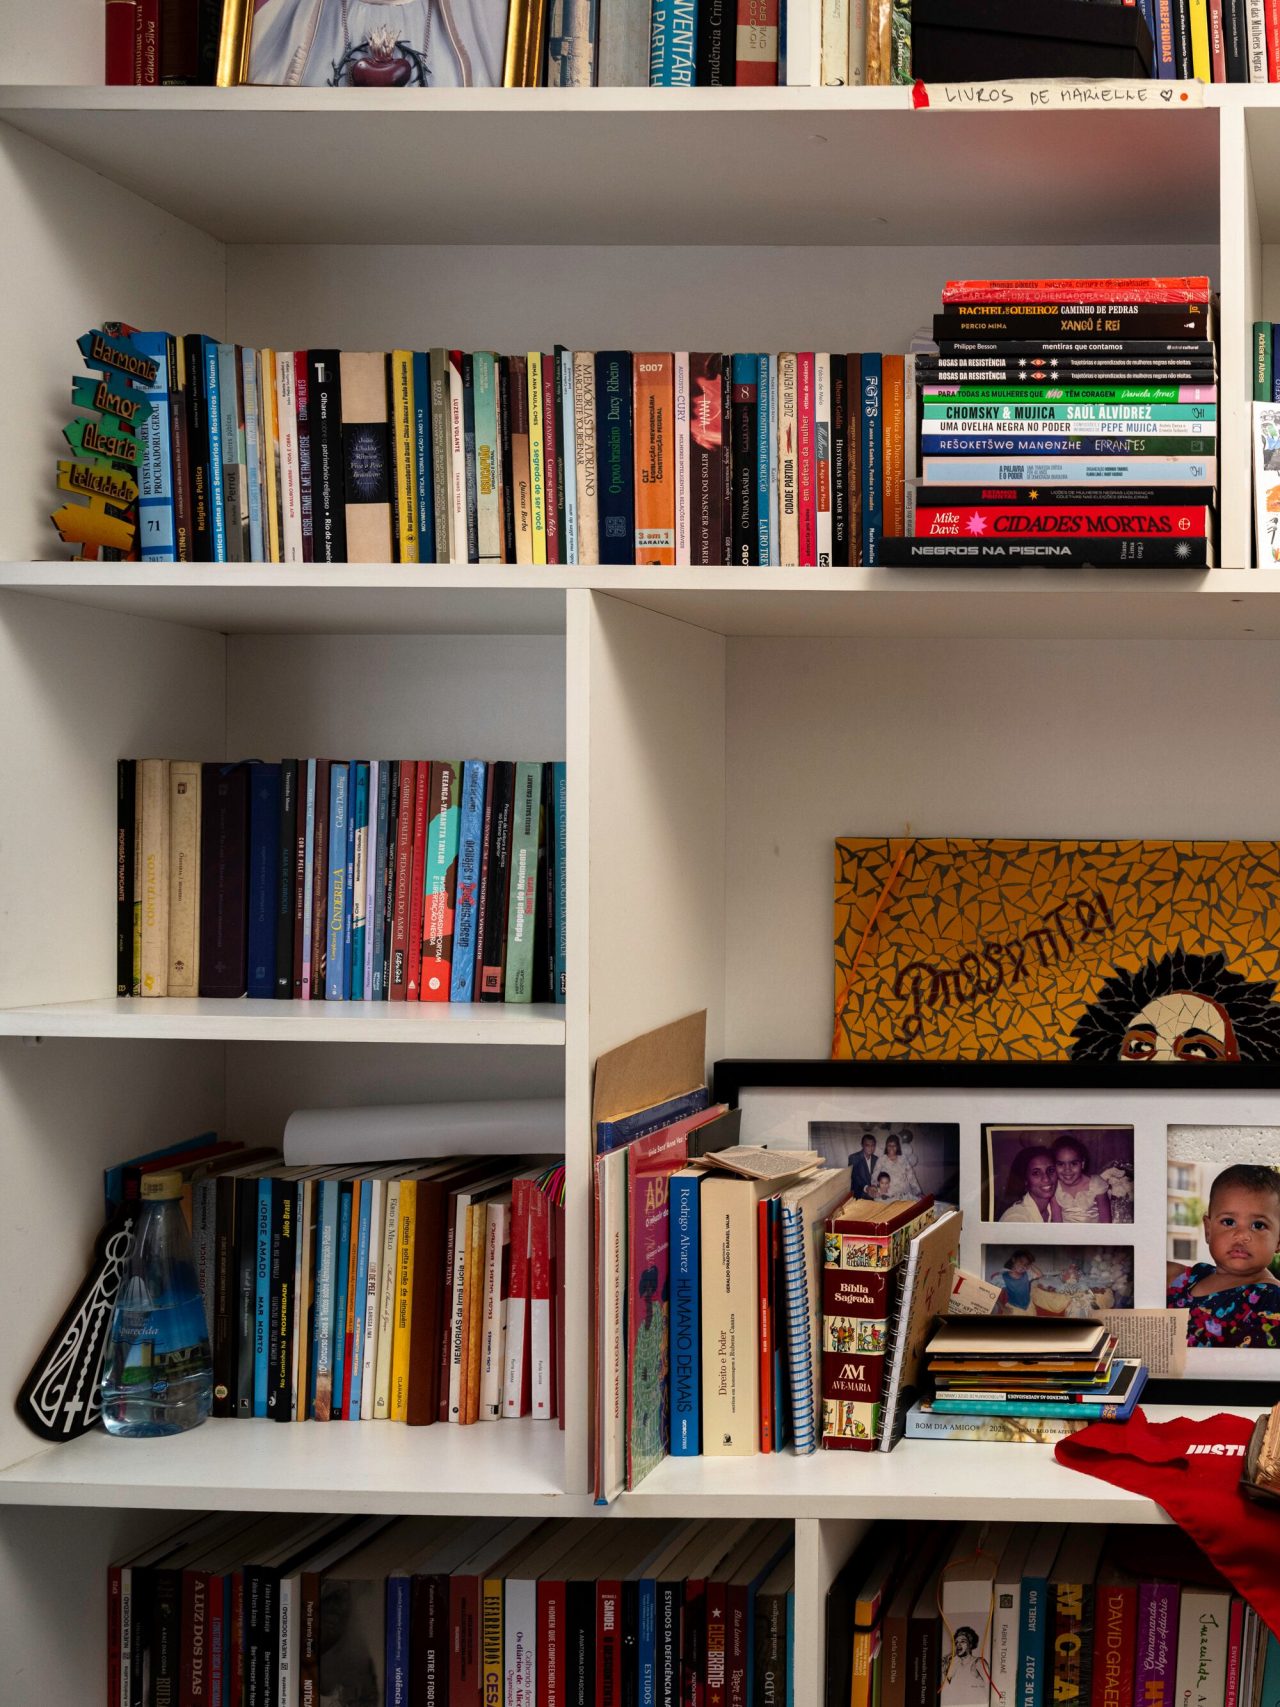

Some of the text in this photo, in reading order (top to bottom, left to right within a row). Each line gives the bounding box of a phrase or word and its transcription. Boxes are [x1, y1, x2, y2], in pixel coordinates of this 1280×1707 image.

[1252, 20, 1260, 49] Mulheres
[1253, 50, 1262, 72] Negras
[945, 88, 1014, 103] LIVROS
[1030, 90, 1050, 105] DE
[92, 336, 157, 381] Harmonia
[640, 364, 663, 372] 2007
[95, 382, 142, 420] Amor
[784, 359, 794, 418] ZUENIR VENTURA
[864, 376, 878, 418] FGTS
[576, 364, 584, 465] MARGUERITE YOURCENAR
[582, 364, 596, 497] MEMÓRIAS DE ADRIANO
[940, 422, 959, 431] UMA
[960, 422, 994, 431] OVELHA
[996, 422, 1026, 432] NEGRA
[1027, 422, 1040, 432] NO
[1041, 422, 1071, 432] PODER
[1101, 422, 1124, 433] PEPE
[1126, 422, 1158, 433] MUJICA
[84, 424, 138, 462] Alegria
[151, 404, 163, 495] PROCURADORIA GERAL
[784, 460, 794, 515] CIDADE PARTIDA
[148, 520, 160, 532] 71
[930, 524, 959, 535] Davis
[934, 512, 960, 524] Mike
[993, 515, 1173, 533] CIDADES MORTAS
[912, 546, 1072, 556] NEGROS NA PISCINA
[396, 778, 410, 940] GABRIEL CHALITA PEDAGOGIA AMOR
[330, 868, 344, 931] CINDERELA
[259, 1200, 267, 1236] JORGE
[258, 1240, 266, 1279] AMADO
[676, 1188, 692, 1413] Rodrigo Alvarez HUMANO DEMAIS
[834, 1292, 875, 1304] Sagrada
[840, 1283, 869, 1294] Bíblia
[457, 1305, 463, 1318] da
[454, 1320, 464, 1365] MEMÓRIAS
[831, 1381, 872, 1393] AVE-MARIA
[604, 1600, 615, 1631] SANDEL
[1028, 1590, 1038, 1632] JASIEL IVO
[1106, 1595, 1124, 1649] DAVID
[192, 1580, 204, 1696] A LUZ DOS DIAS
[281, 1640, 289, 1659] NUEVA
[484, 1596, 500, 1666] ESFARRAPADOS
[1144, 1600, 1157, 1671] Chimamanda
[1228, 1646, 1237, 1689] ENVELHECER
